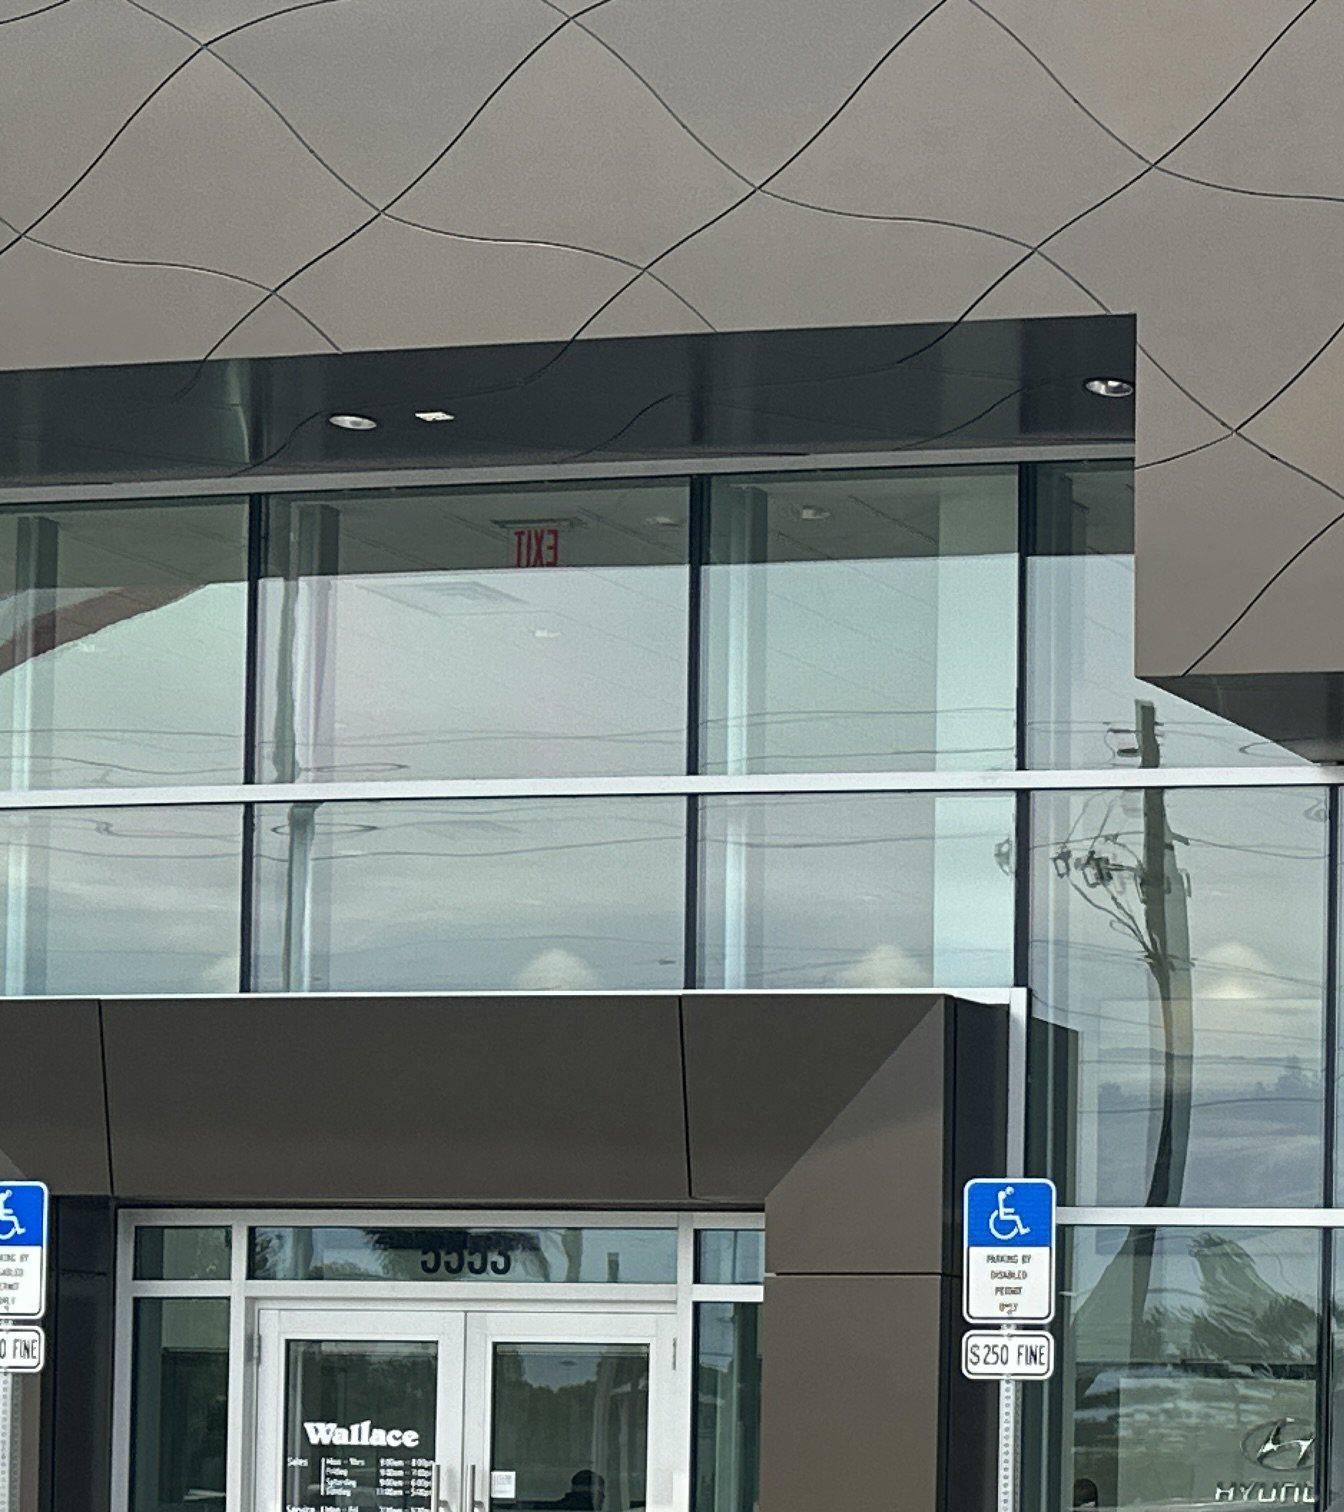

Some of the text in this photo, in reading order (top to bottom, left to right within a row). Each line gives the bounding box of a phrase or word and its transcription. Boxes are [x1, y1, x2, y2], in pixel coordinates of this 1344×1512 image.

[986, 1254, 1032, 1264] PARKING BY
[990, 1270, 1028, 1280] DISABLED
[994, 1286, 1023, 1296] PERMIT
[998, 1302, 1019, 1312] ONLY
[12, 1338, 38, 1360] FINE
[969, 1343, 1047, 1367] $250 FINE
[303, 1420, 419, 1448] Wallace
[1215, 1481, 1314, 1502] HYUND
